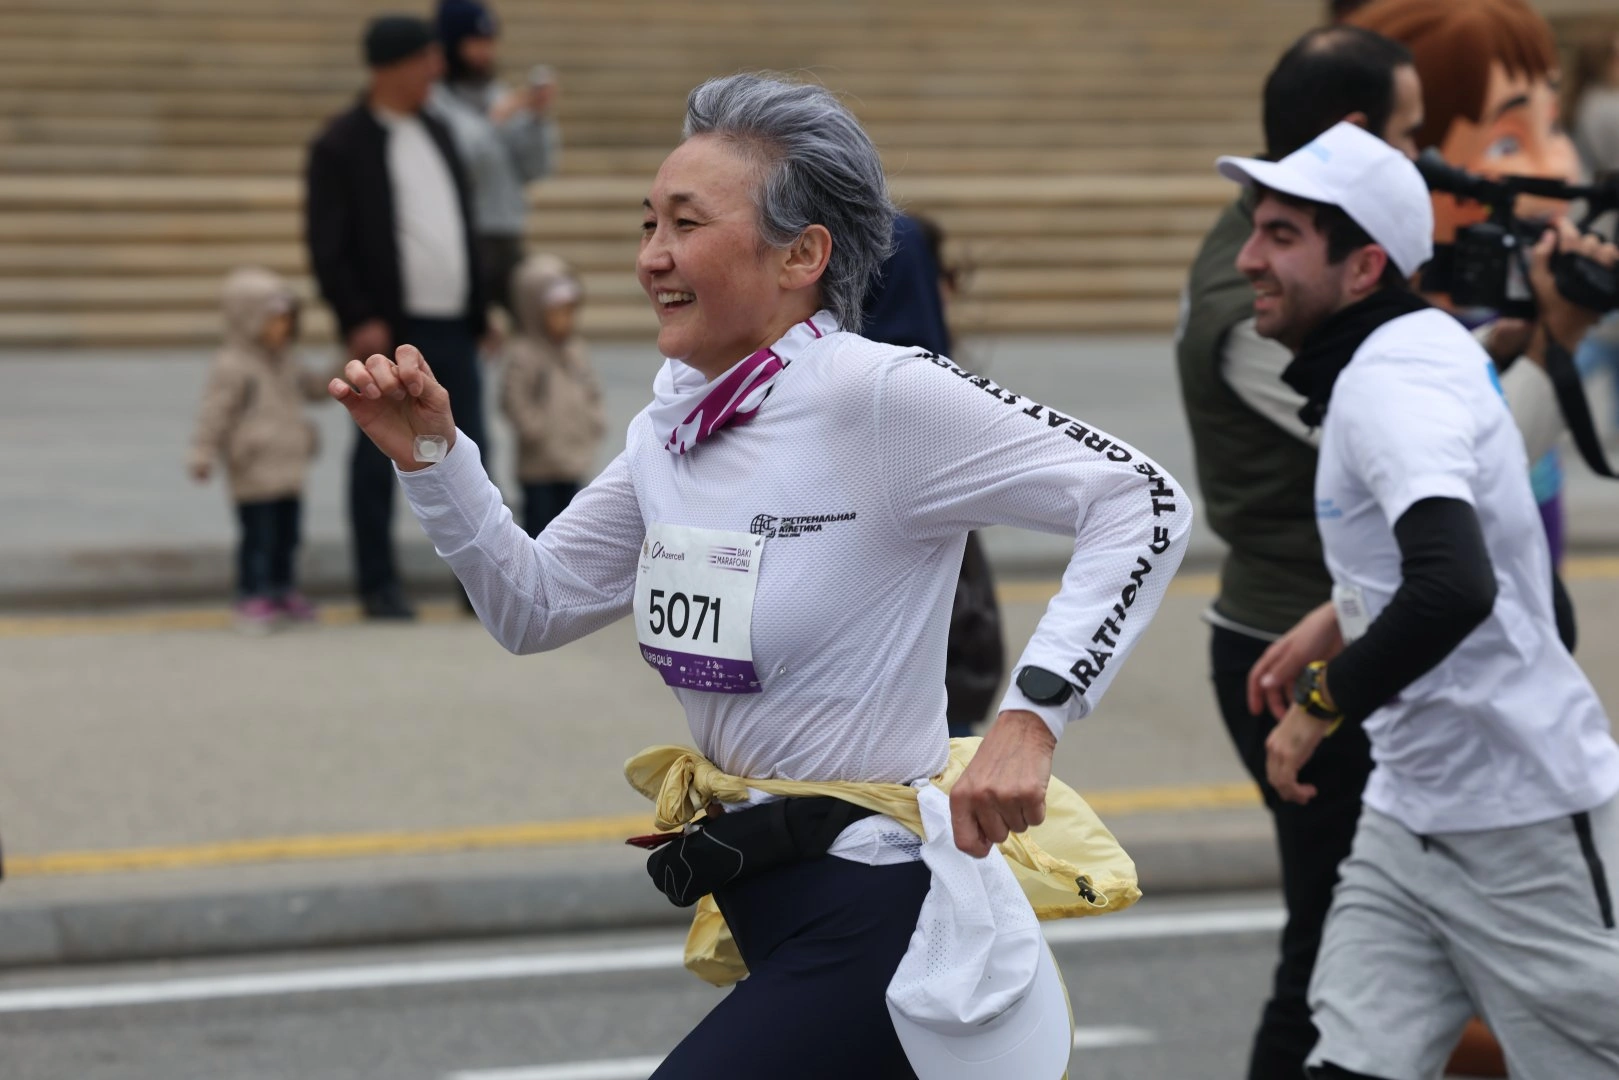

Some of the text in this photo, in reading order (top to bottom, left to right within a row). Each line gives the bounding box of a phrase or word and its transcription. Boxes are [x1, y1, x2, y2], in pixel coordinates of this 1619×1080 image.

[1022, 404, 1133, 463] GREAT
[661, 550, 685, 561] Azercell
[736, 548, 752, 558] BAKI
[715, 556, 751, 568] MARAFONU
[649, 588, 722, 643] 5071
